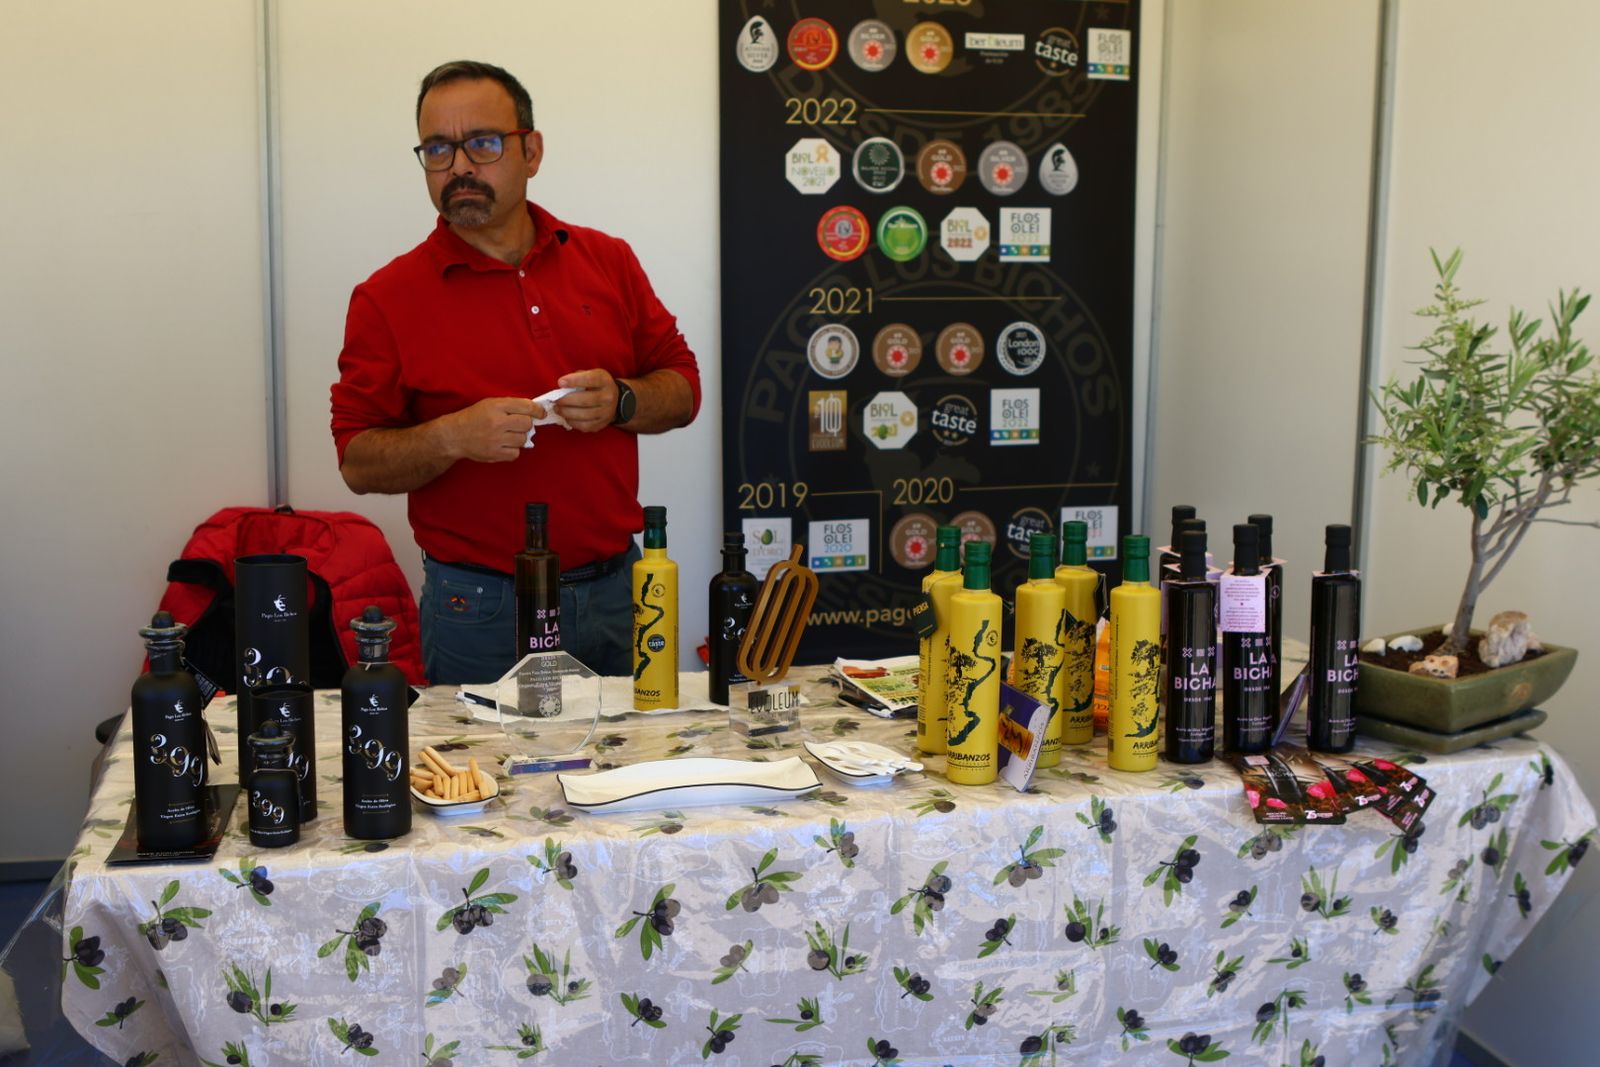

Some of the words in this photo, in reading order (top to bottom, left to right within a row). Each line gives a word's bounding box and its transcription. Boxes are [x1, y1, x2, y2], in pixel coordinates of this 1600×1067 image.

[1035, 40, 1079, 67] taste
[785, 97, 857, 125] 2022
[1010, 212, 1040, 223] FLOS
[1010, 223, 1040, 234] OLEI
[946, 236, 973, 249] 2022
[808, 287, 873, 314] 2021
[1009, 338, 1040, 349] London
[870, 403, 898, 417] BIOL
[943, 402, 969, 416] great
[1002, 399, 1029, 409] FLOS
[1002, 408, 1029, 419] OLEI
[932, 410, 977, 434] taste
[738, 482, 809, 509] 2019
[892, 477, 954, 505] 2020
[1020, 515, 1046, 529] great
[1075, 510, 1103, 520] FLOS
[824, 523, 853, 534] FLOS
[1007, 523, 1045, 543] tas
[824, 533, 853, 545] OLEI
[824, 544, 853, 553] 2020
[544, 622, 559, 634] LA
[529, 634, 560, 649] BICH
[1250, 652, 1267, 665] LA
[1344, 654, 1359, 667] LA
[1190, 662, 1209, 676] LA
[1327, 669, 1359, 682] BICH
[348, 724, 402, 782] 399
[149, 733, 204, 788] 399
[252, 790, 285, 825] 399
